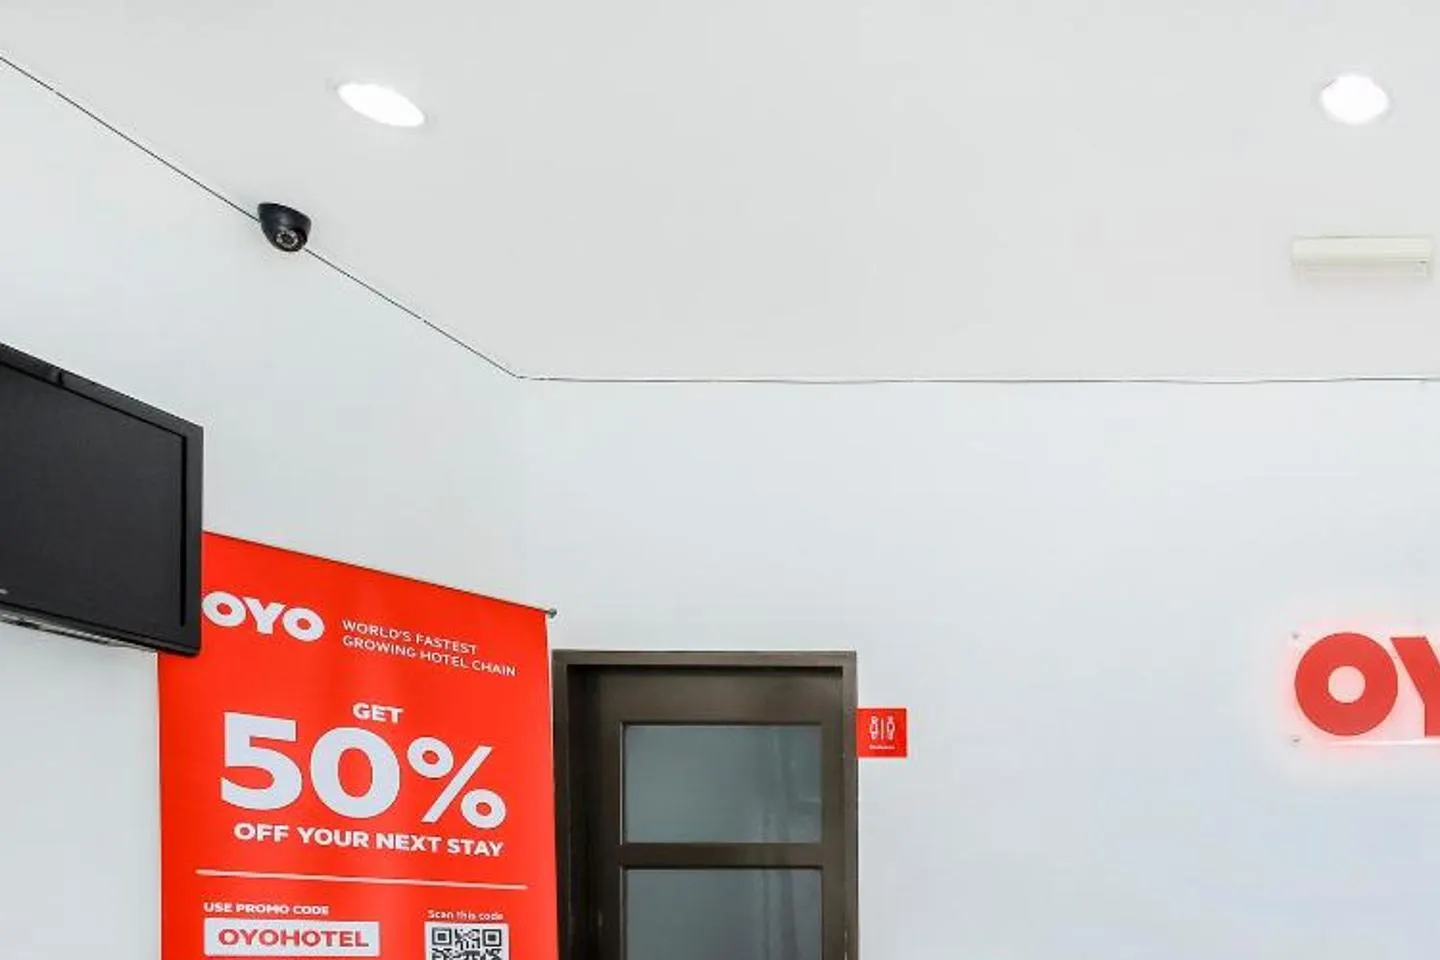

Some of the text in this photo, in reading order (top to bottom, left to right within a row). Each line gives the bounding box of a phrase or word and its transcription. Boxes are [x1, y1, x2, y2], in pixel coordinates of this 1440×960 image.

[201, 591, 325, 642] OYO
[342, 619, 477, 655] WORLD'S FASTEST
[343, 635, 516, 677] GROWING HOTEL CHAIN
[352, 702, 403, 723] GET
[221, 711, 506, 829] 50%
[233, 822, 504, 857] OFF YOUR NEXT STAY
[203, 902, 329, 915] USE PROMO CODE
[427, 909, 504, 921] Scan this code
[218, 928, 370, 947] OYOHOTEL
